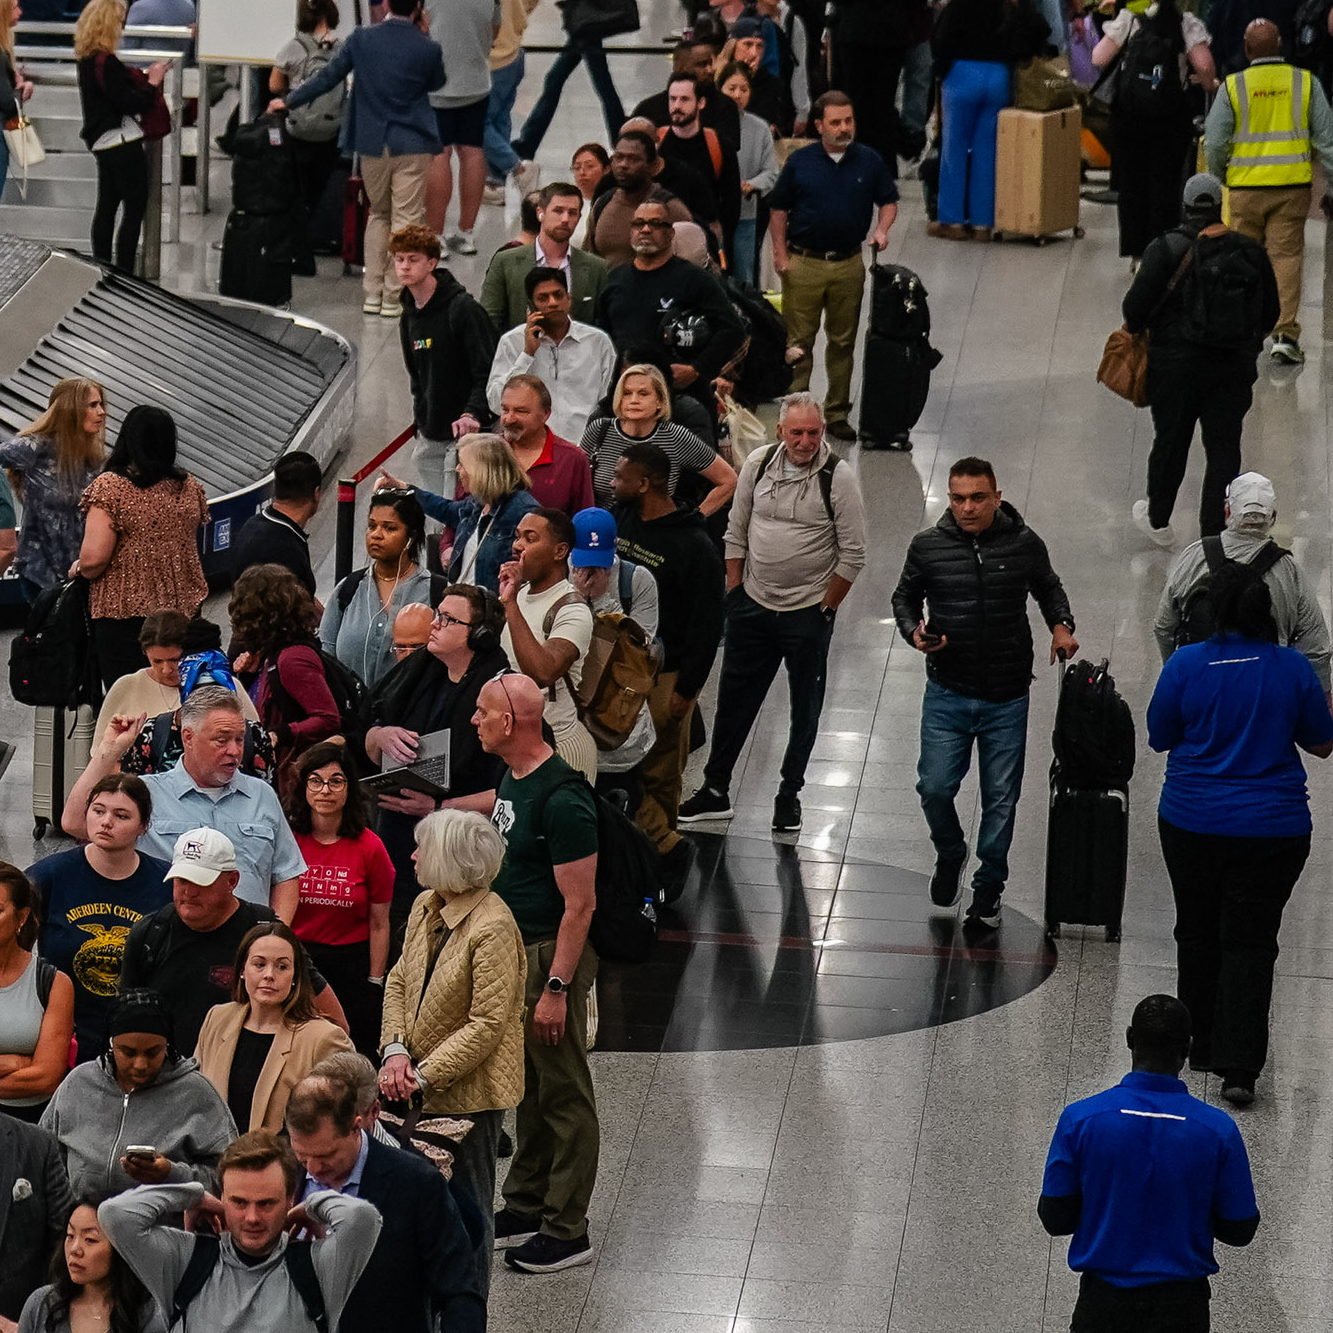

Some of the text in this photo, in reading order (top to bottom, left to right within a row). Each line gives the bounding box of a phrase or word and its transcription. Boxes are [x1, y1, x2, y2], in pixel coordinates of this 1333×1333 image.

[305, 897, 354, 907] PERIODICALLY
[66, 903, 112, 923] ABERDEEN
[95, 956, 118, 965] FFA
